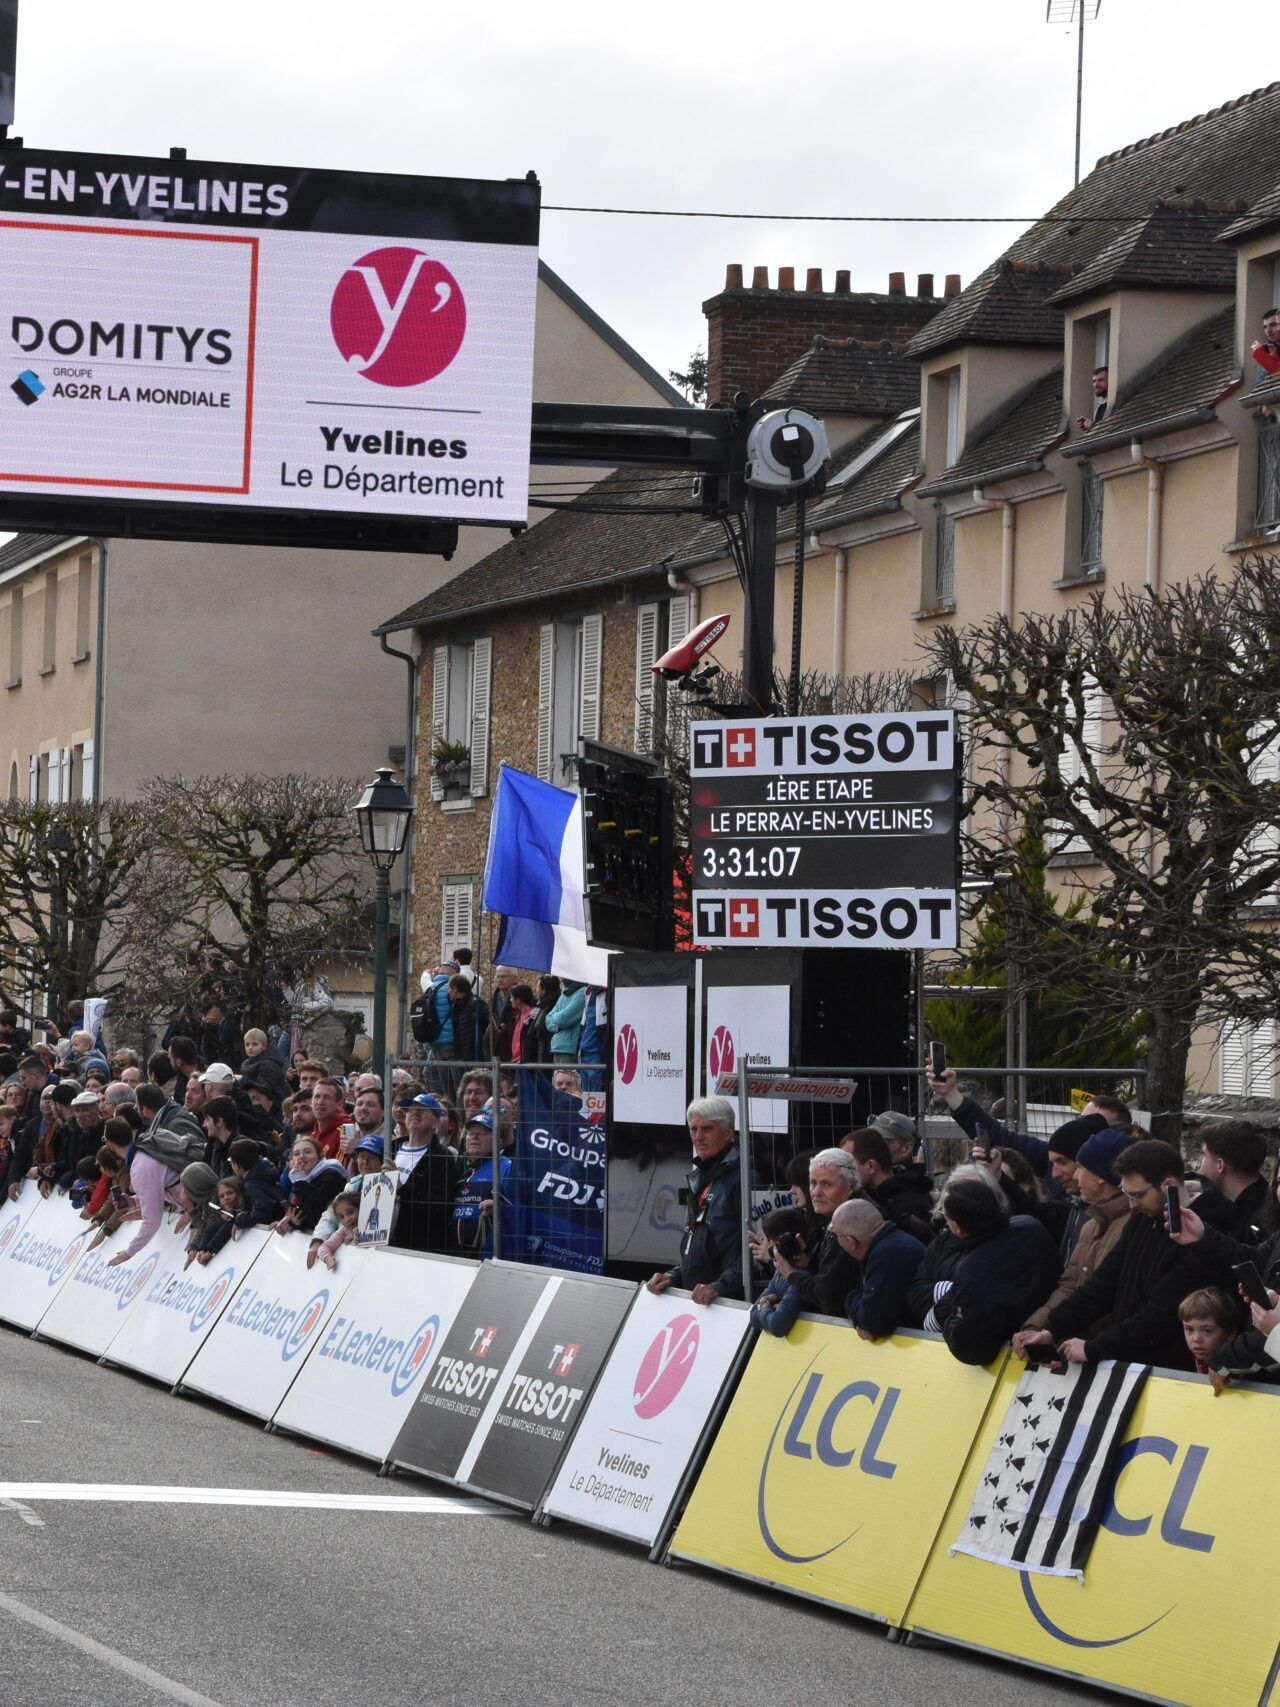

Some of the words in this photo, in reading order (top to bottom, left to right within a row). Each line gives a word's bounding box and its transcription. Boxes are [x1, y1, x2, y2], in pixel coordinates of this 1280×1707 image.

[12, 316, 232, 366] DOMITYS
[53, 367, 93, 379] GROUPE
[53, 383, 102, 402] AG2R
[107, 385, 131, 402] LA
[136, 388, 230, 408] MONDIALE
[319, 426, 468, 460] Yvelines
[280, 462, 313, 488] Le
[323, 464, 504, 500] Département
[763, 720, 949, 767] TISSOT
[766, 775, 811, 802] 1ÈRE
[816, 778, 874, 800] ETAPE
[710, 812, 730, 833] LE
[735, 808, 934, 833] PERRAY-EN-YVELINES
[702, 846, 802, 878] 3:31:07
[766, 897, 952, 940] TISSOT
[647, 1049, 671, 1063] Yvelines
[647, 1065, 654, 1078] Le
[654, 1065, 683, 1079] Département
[745, 1053, 771, 1066] Yvelines
[775, 1081, 851, 1099] Guillaume
[774, 1192, 793, 1209] des
[10, 1232, 64, 1272] E.Leclerc
[74, 1252, 132, 1295] E.Leclerc
[145, 1271, 207, 1314] E.Leclerc
[226, 1288, 297, 1342] E.Leclerc
[318, 1317, 402, 1375] E.Leclerc
[431, 1356, 499, 1400] TISSOT
[506, 1374, 584, 1423] TISSOT
[494, 1413, 513, 1427] SWISS
[511, 1417, 536, 1434] WATCHES
[534, 1423, 553, 1439] SINCE
[783, 1371, 902, 1480] LCL
[596, 1446, 651, 1480] Yvelines
[569, 1469, 585, 1491] Le
[584, 1474, 653, 1513] Département
